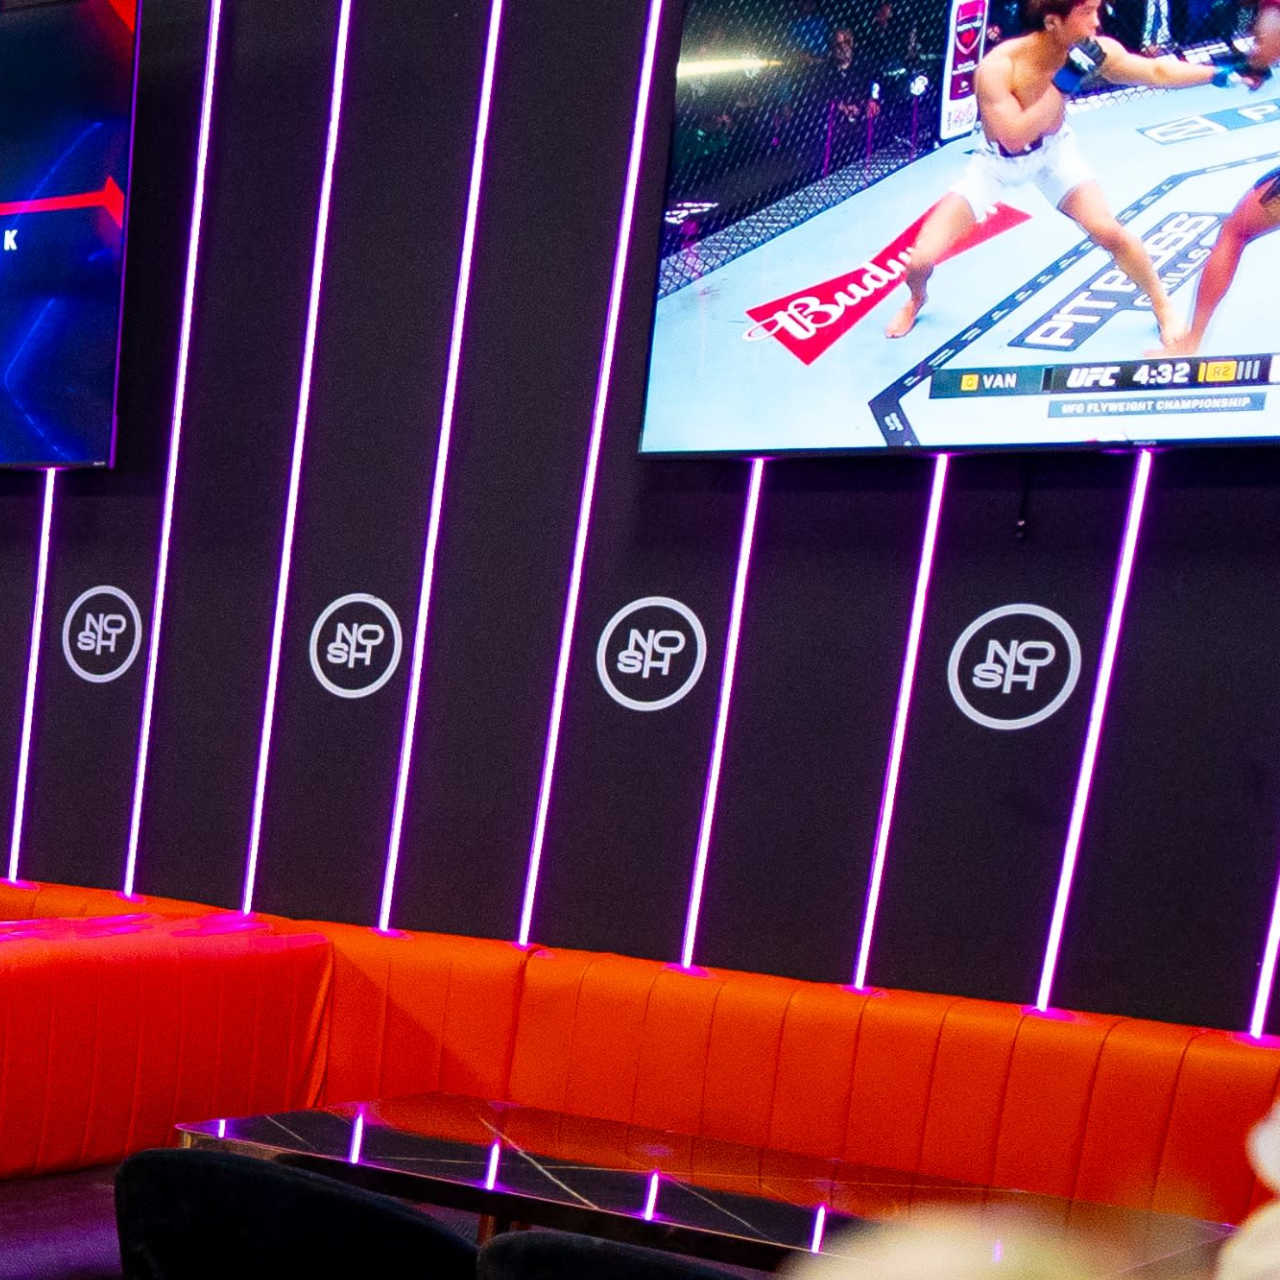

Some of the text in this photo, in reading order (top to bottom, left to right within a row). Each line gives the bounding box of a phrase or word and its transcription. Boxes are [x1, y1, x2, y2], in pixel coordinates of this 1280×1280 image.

[982, 373, 1017, 389] VAN
[1066, 366, 1121, 388] UFC
[1132, 362, 1190, 385] 4:32
[1086, 400, 1154, 413] FLYWEIGHT
[1156, 396, 1250, 411] CHAMPIONSHIP
[84, 613, 127, 634] NO
[335, 622, 385, 646] NO
[77, 631, 116, 655] SH
[627, 628, 686, 654] NO
[986, 639, 1057, 666] NO
[326, 642, 372, 669] SH
[617, 650, 671, 678] SH
[972, 662, 1038, 693] SH
